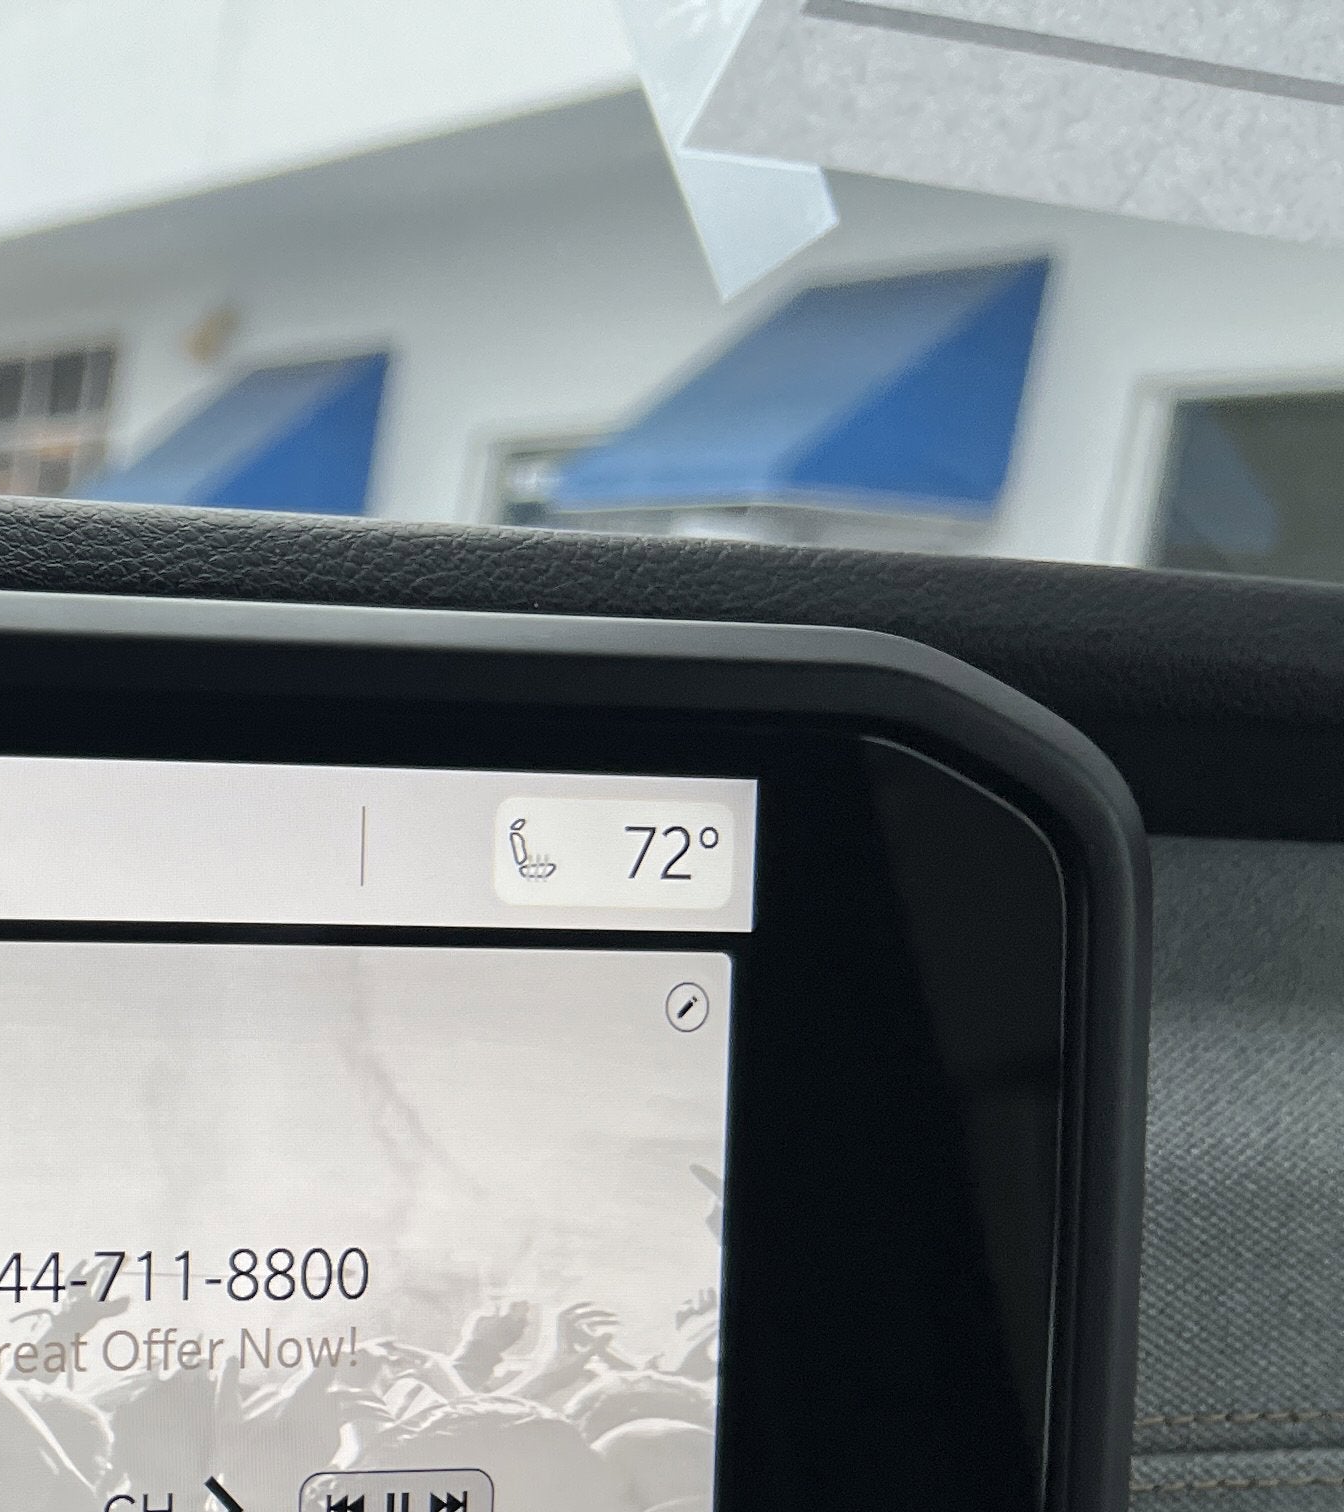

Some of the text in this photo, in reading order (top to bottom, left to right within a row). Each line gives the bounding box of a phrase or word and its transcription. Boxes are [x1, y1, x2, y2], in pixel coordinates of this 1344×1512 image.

[624, 825, 720, 881] 72°
[102, 1328, 223, 1371] Offer
[239, 1327, 358, 1369] Now!
